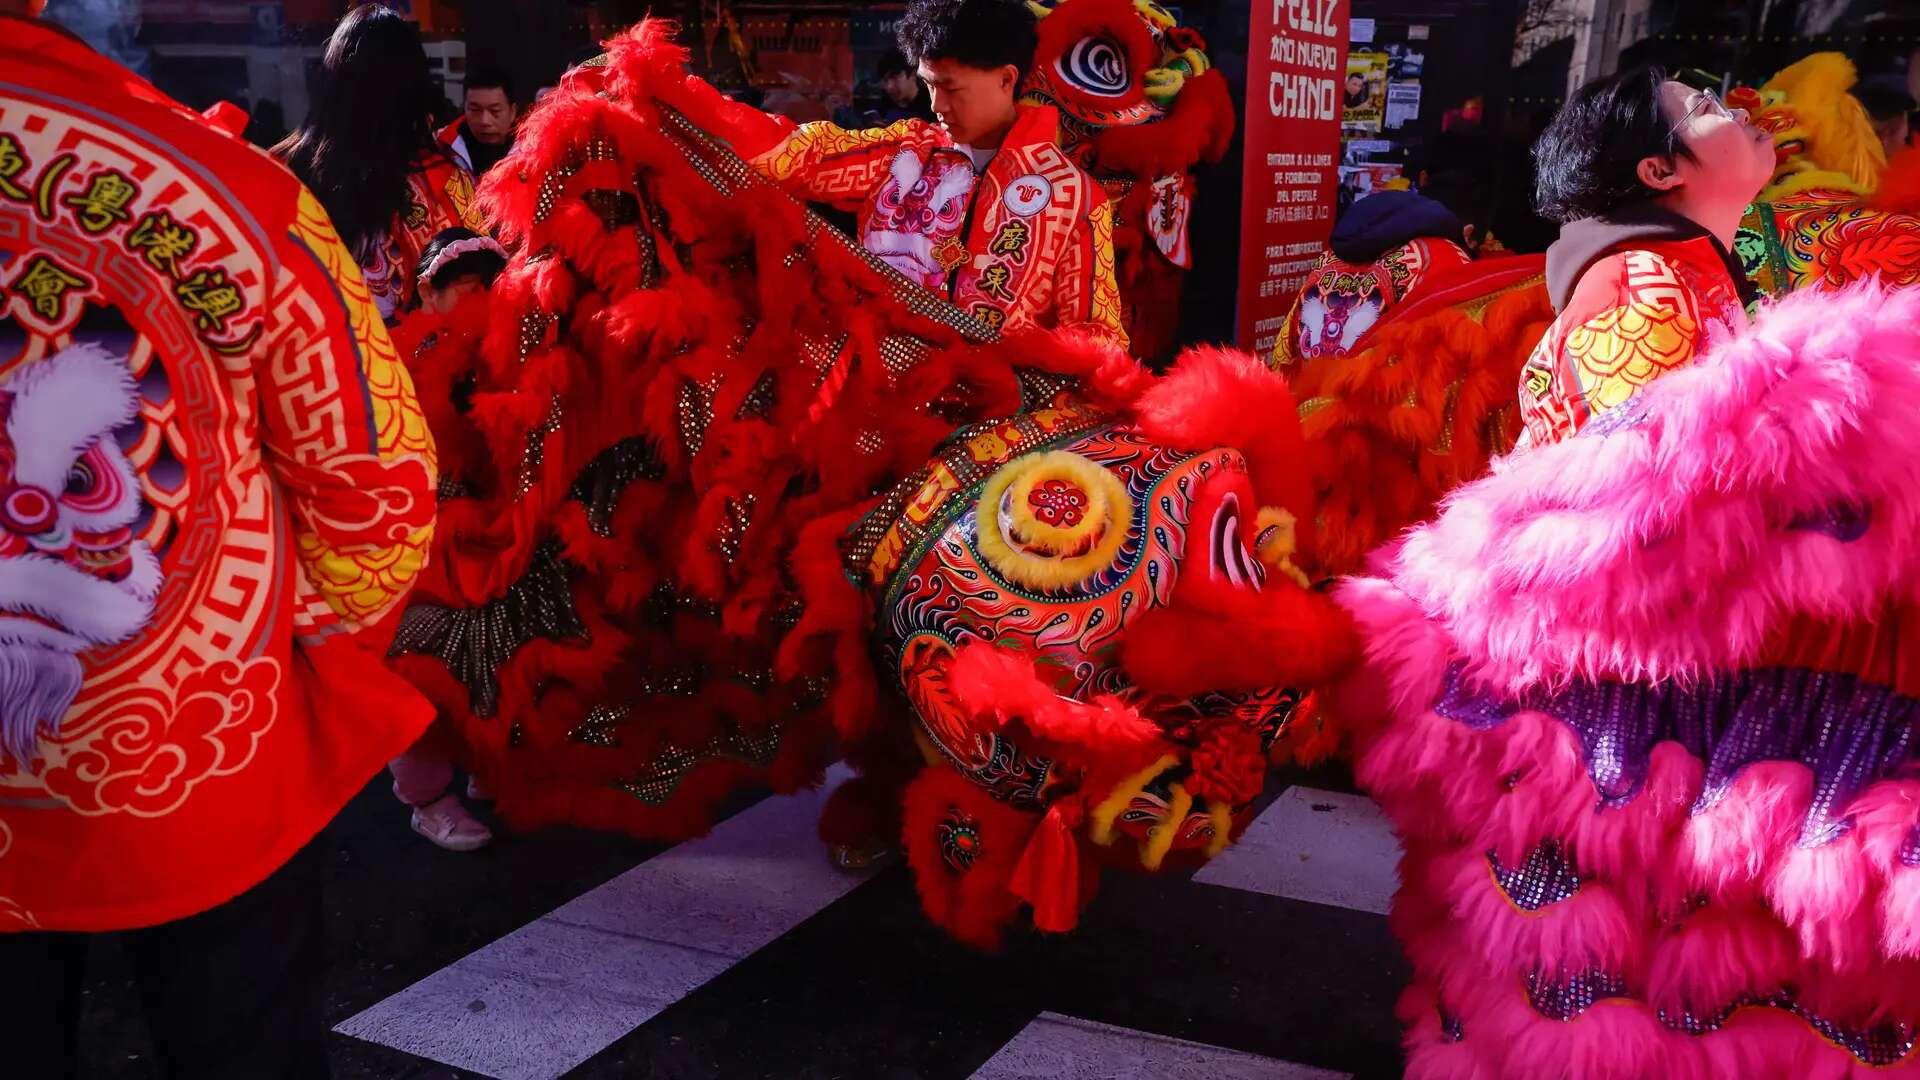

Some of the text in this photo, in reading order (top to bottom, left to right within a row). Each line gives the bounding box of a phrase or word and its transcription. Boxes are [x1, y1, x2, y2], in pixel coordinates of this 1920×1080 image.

[1270, 30, 1337, 71] AÑO NUEVO
[1269, 72, 1336, 120] CHINO
[1274, 172, 1283, 185] DE
[1276, 190, 1289, 203] DEL
